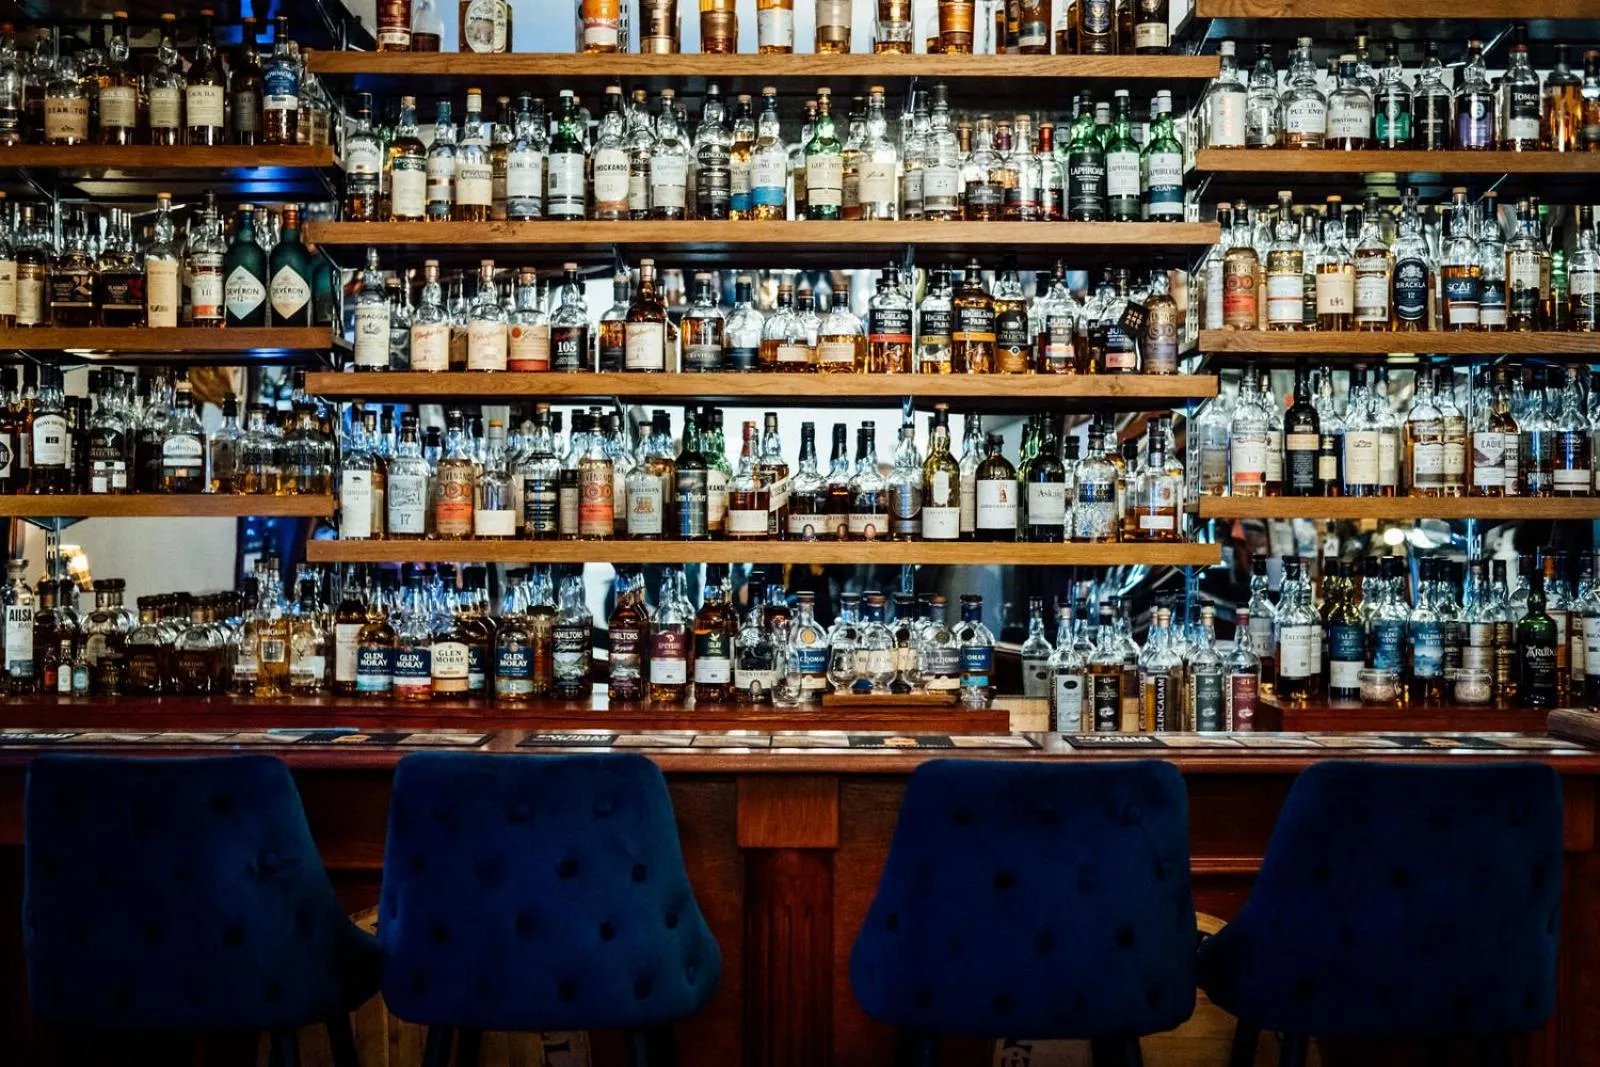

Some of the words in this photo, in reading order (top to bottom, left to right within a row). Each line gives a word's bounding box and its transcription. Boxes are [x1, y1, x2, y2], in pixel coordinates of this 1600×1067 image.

[557, 341, 577, 353] 105
[400, 513, 411, 525] 17
[9, 609, 32, 623] AILSA
[360, 659, 388, 667] MORAY
[396, 660, 424, 668] MORAY
[499, 659, 528, 667] MORAY
